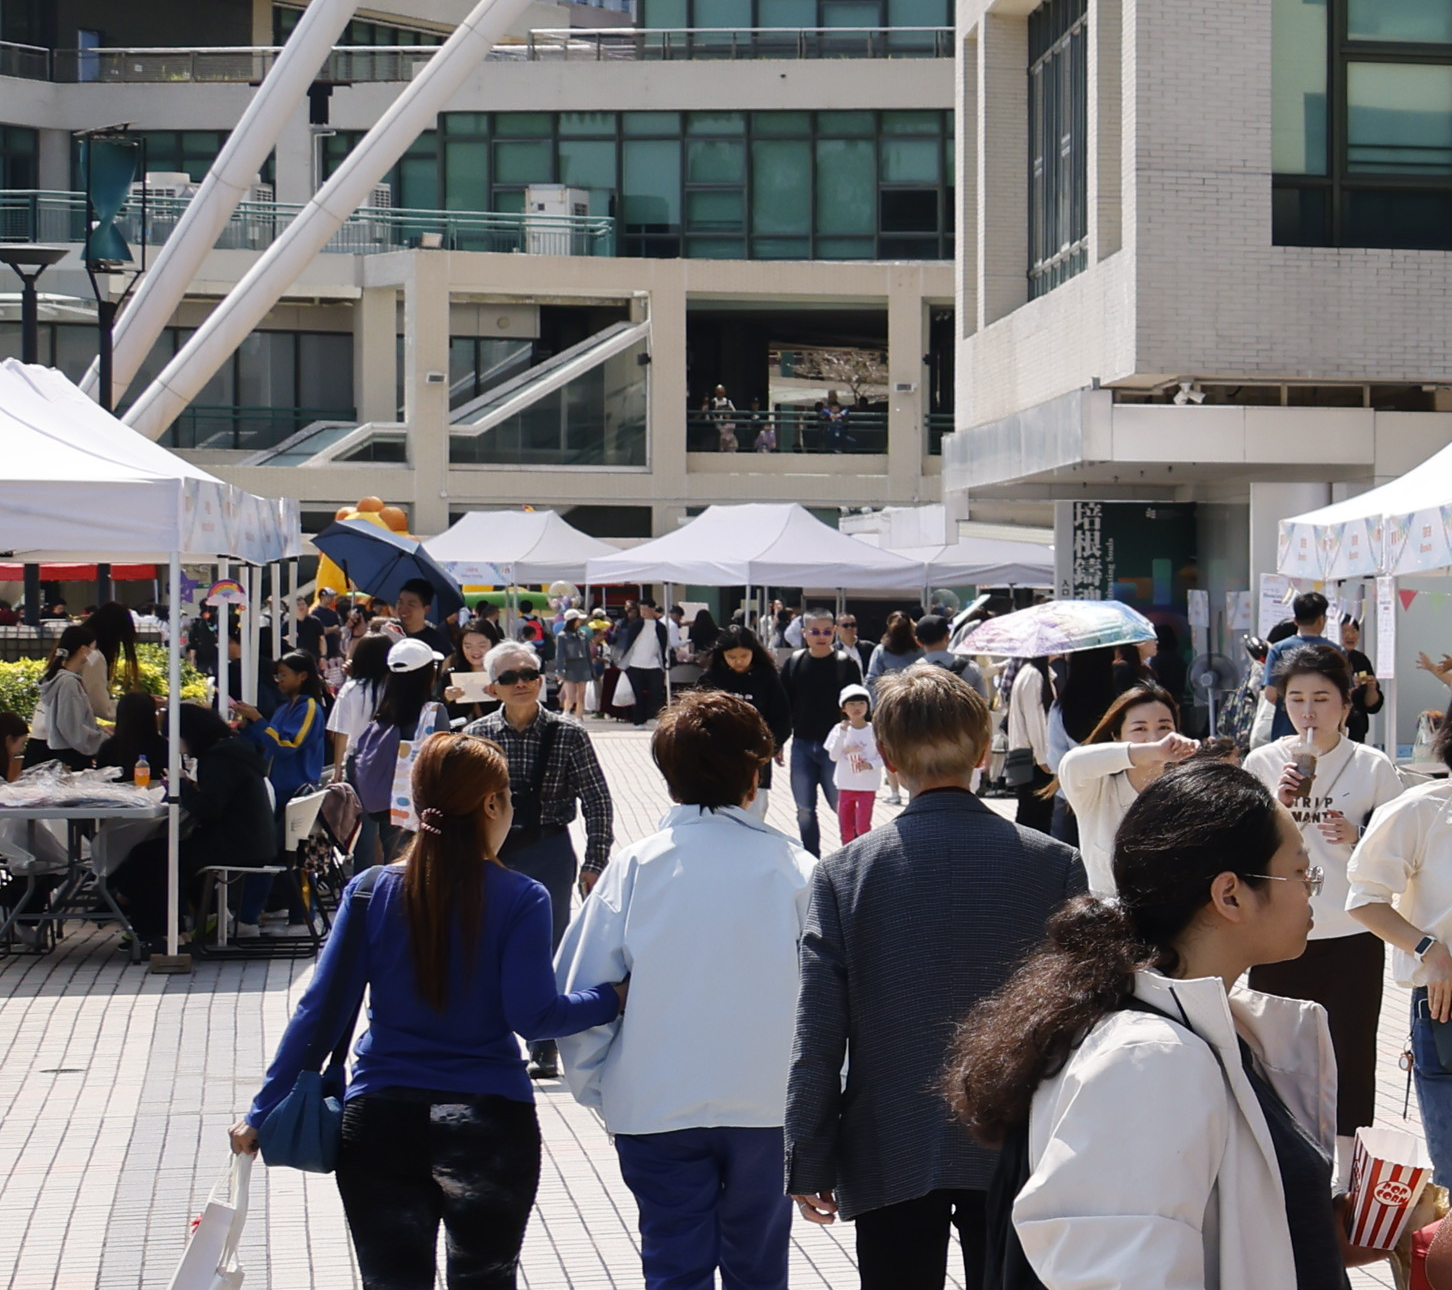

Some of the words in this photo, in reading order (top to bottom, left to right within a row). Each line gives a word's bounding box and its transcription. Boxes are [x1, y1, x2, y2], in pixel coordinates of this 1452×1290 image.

[1293, 796, 1334, 808] TRIP
[1382, 1182, 1409, 1195] POP
[1376, 1189, 1409, 1204] CORN
